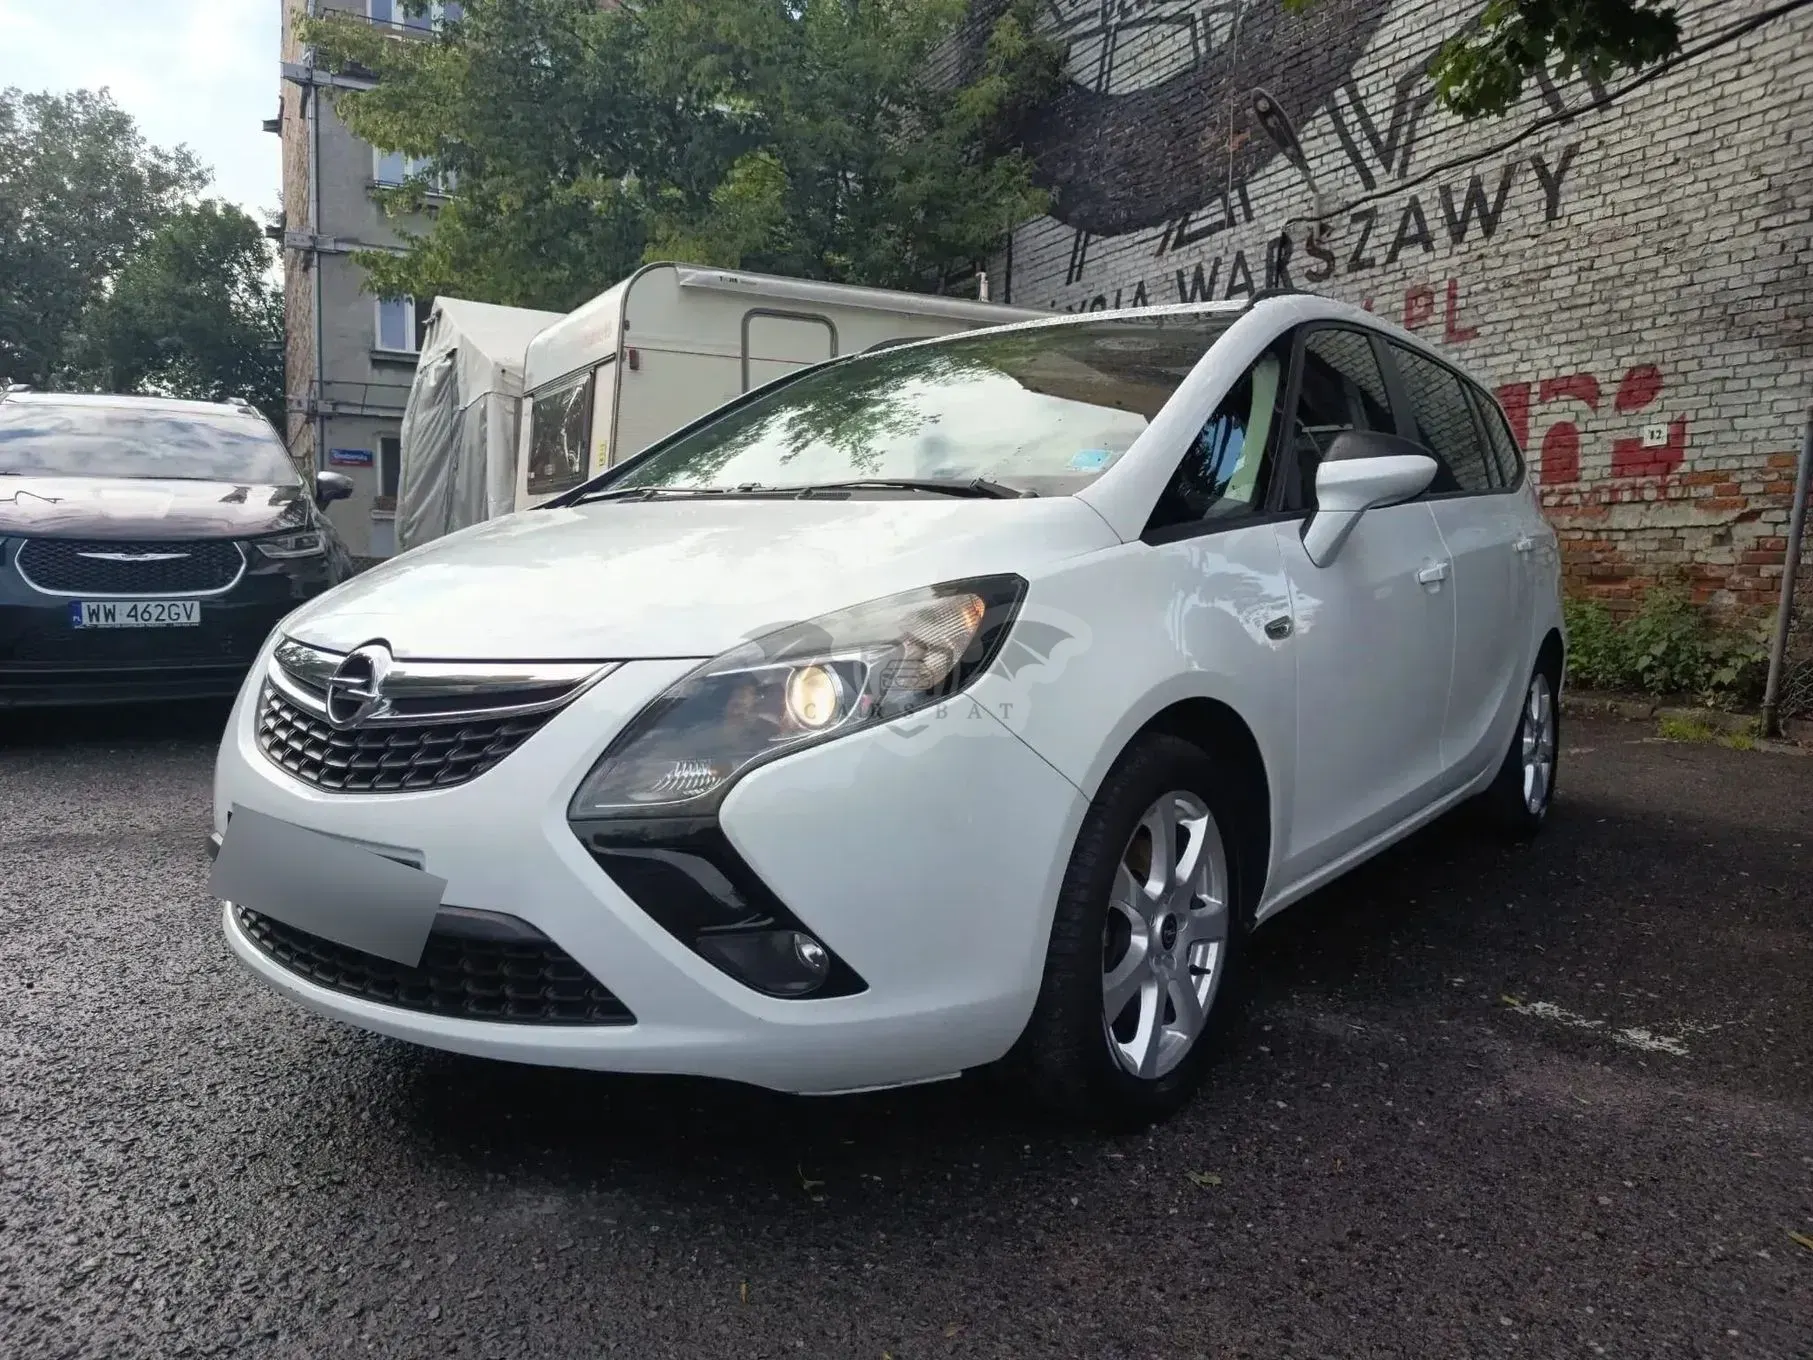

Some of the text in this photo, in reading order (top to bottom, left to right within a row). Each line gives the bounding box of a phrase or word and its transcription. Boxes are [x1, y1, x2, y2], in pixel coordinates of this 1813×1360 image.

[1176, 141, 1580, 303] WARSZAWY
[86, 602, 195, 623] WW 462GV
